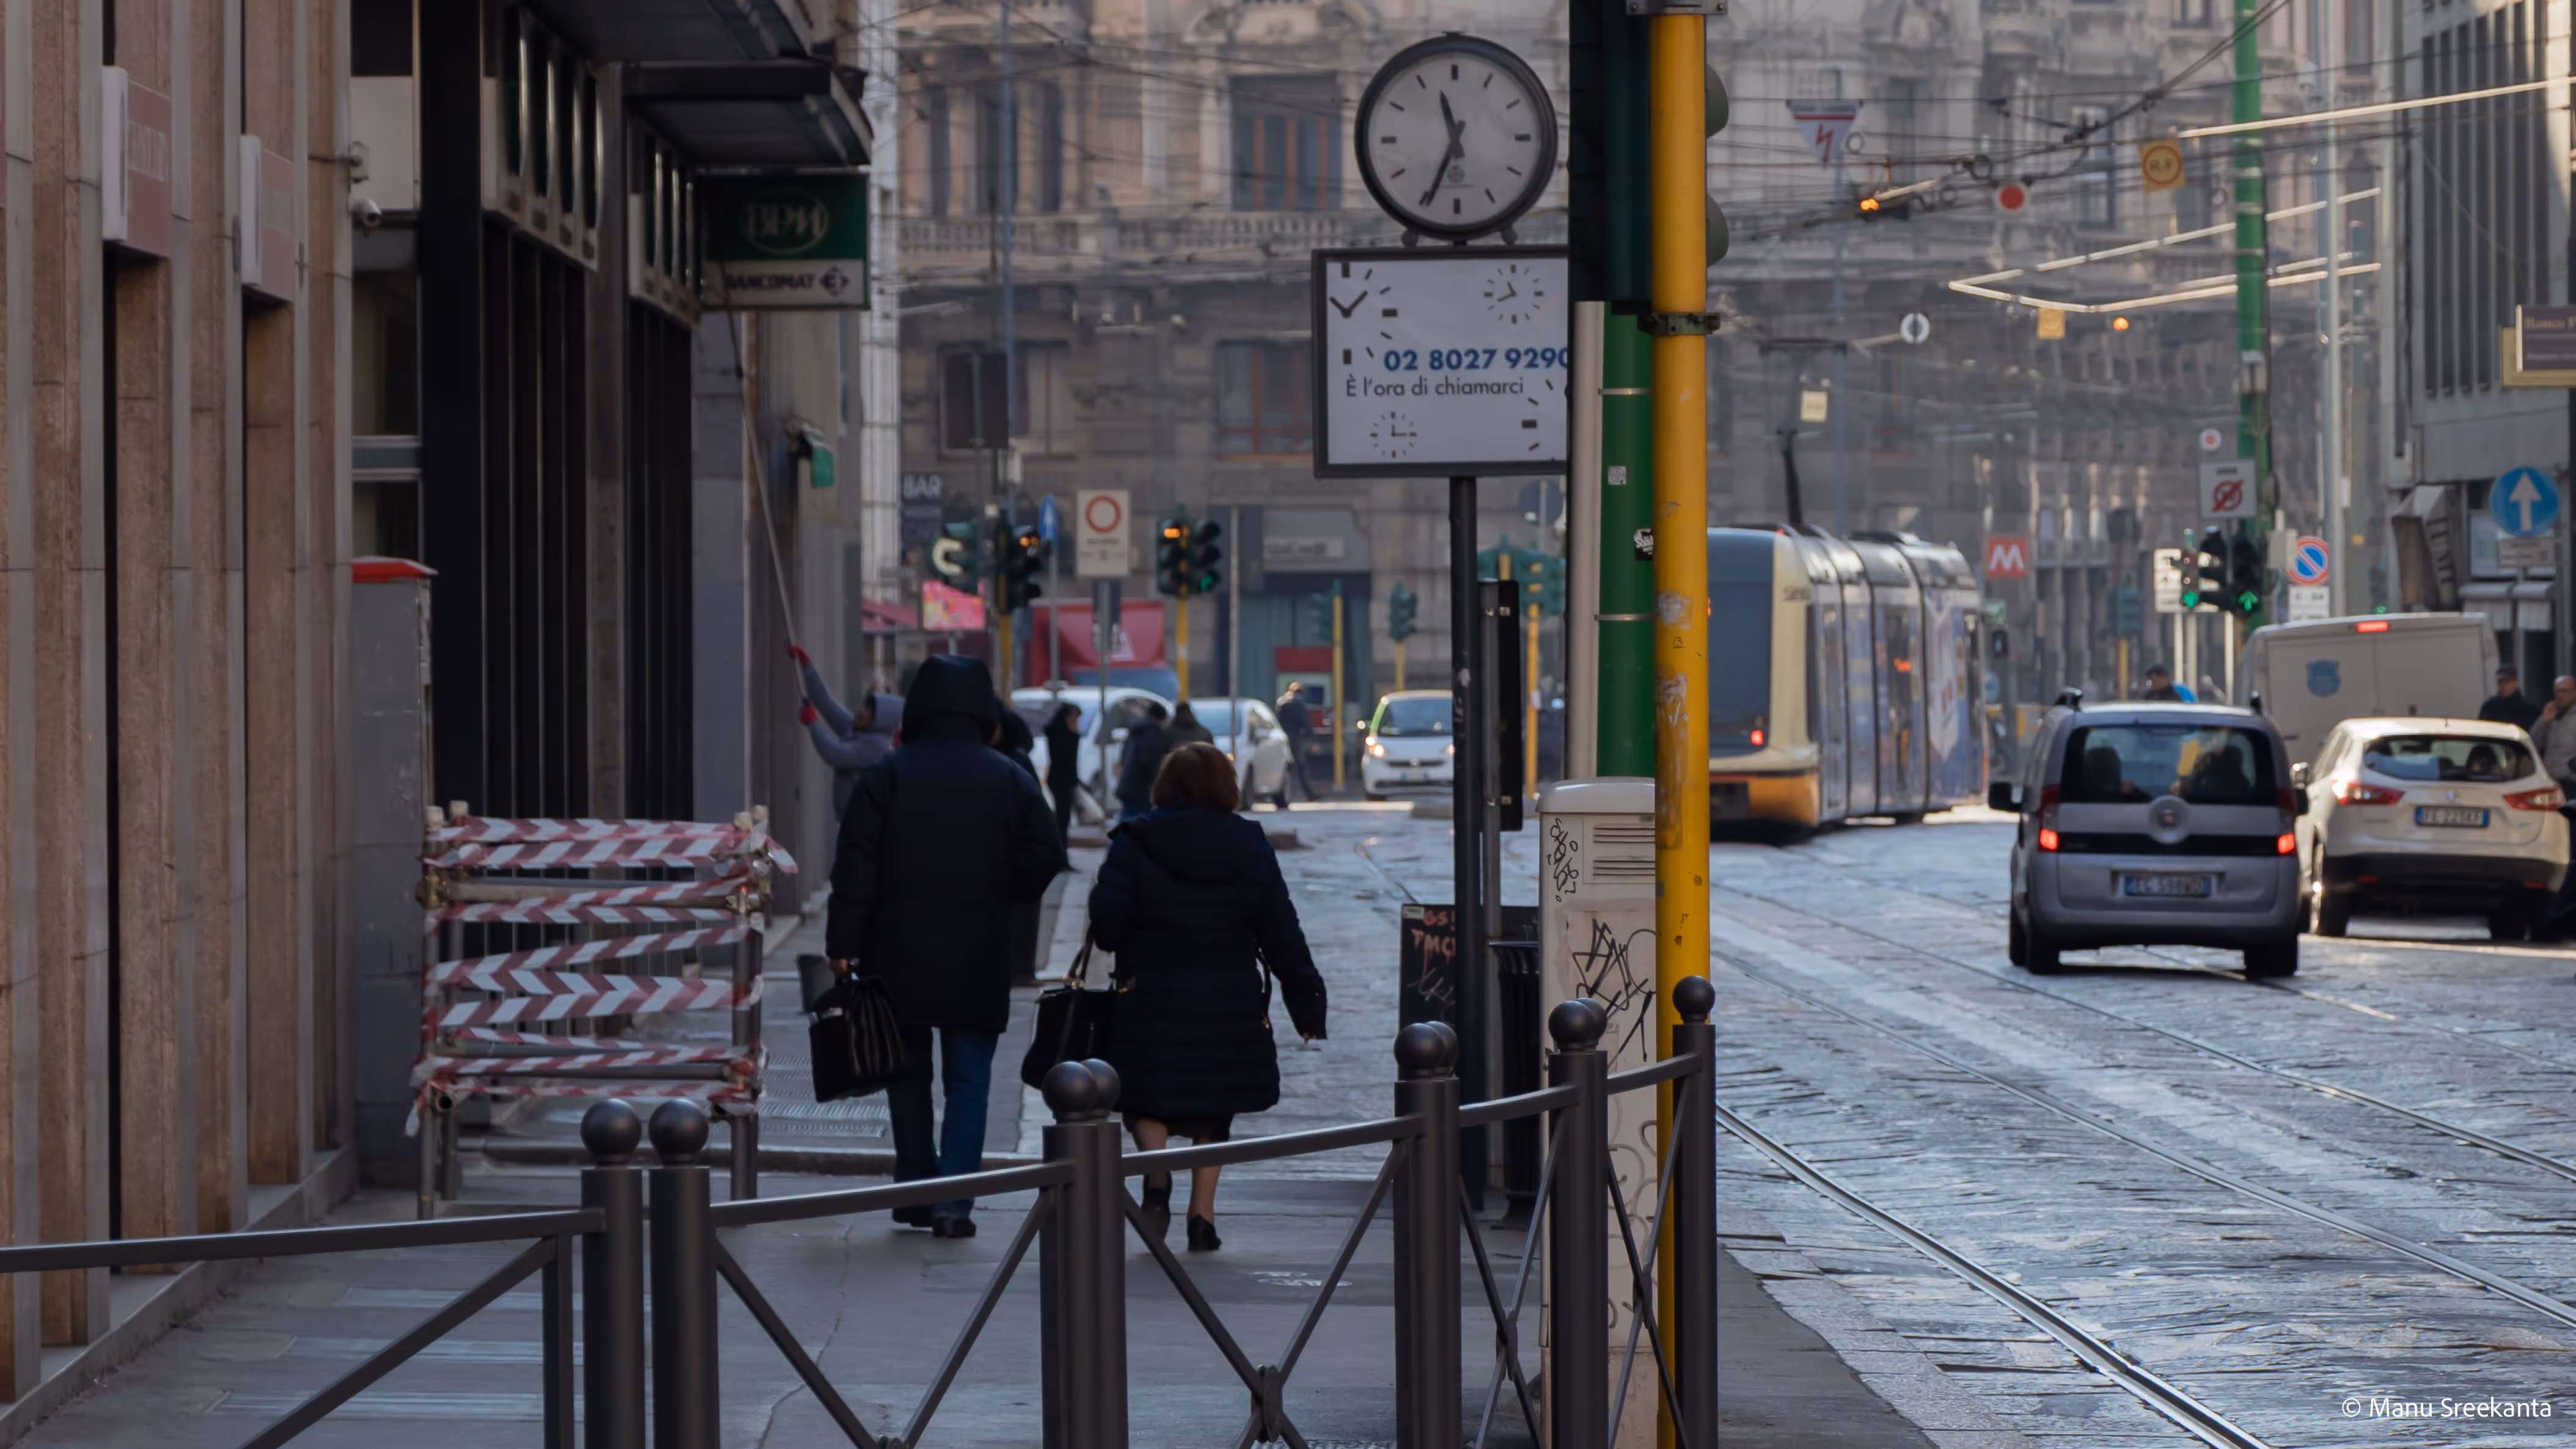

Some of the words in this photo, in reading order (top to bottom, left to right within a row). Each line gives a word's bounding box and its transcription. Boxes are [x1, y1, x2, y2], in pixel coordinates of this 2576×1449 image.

[1384, 349, 1418, 371] 02
[1429, 348, 1497, 370] 8027
[1346, 373, 1356, 397] È
[1412, 375, 1428, 395] di
[1435, 374, 1523, 395] chiamarci
[903, 475, 942, 499] BAR
[1990, 544, 2024, 571] M
